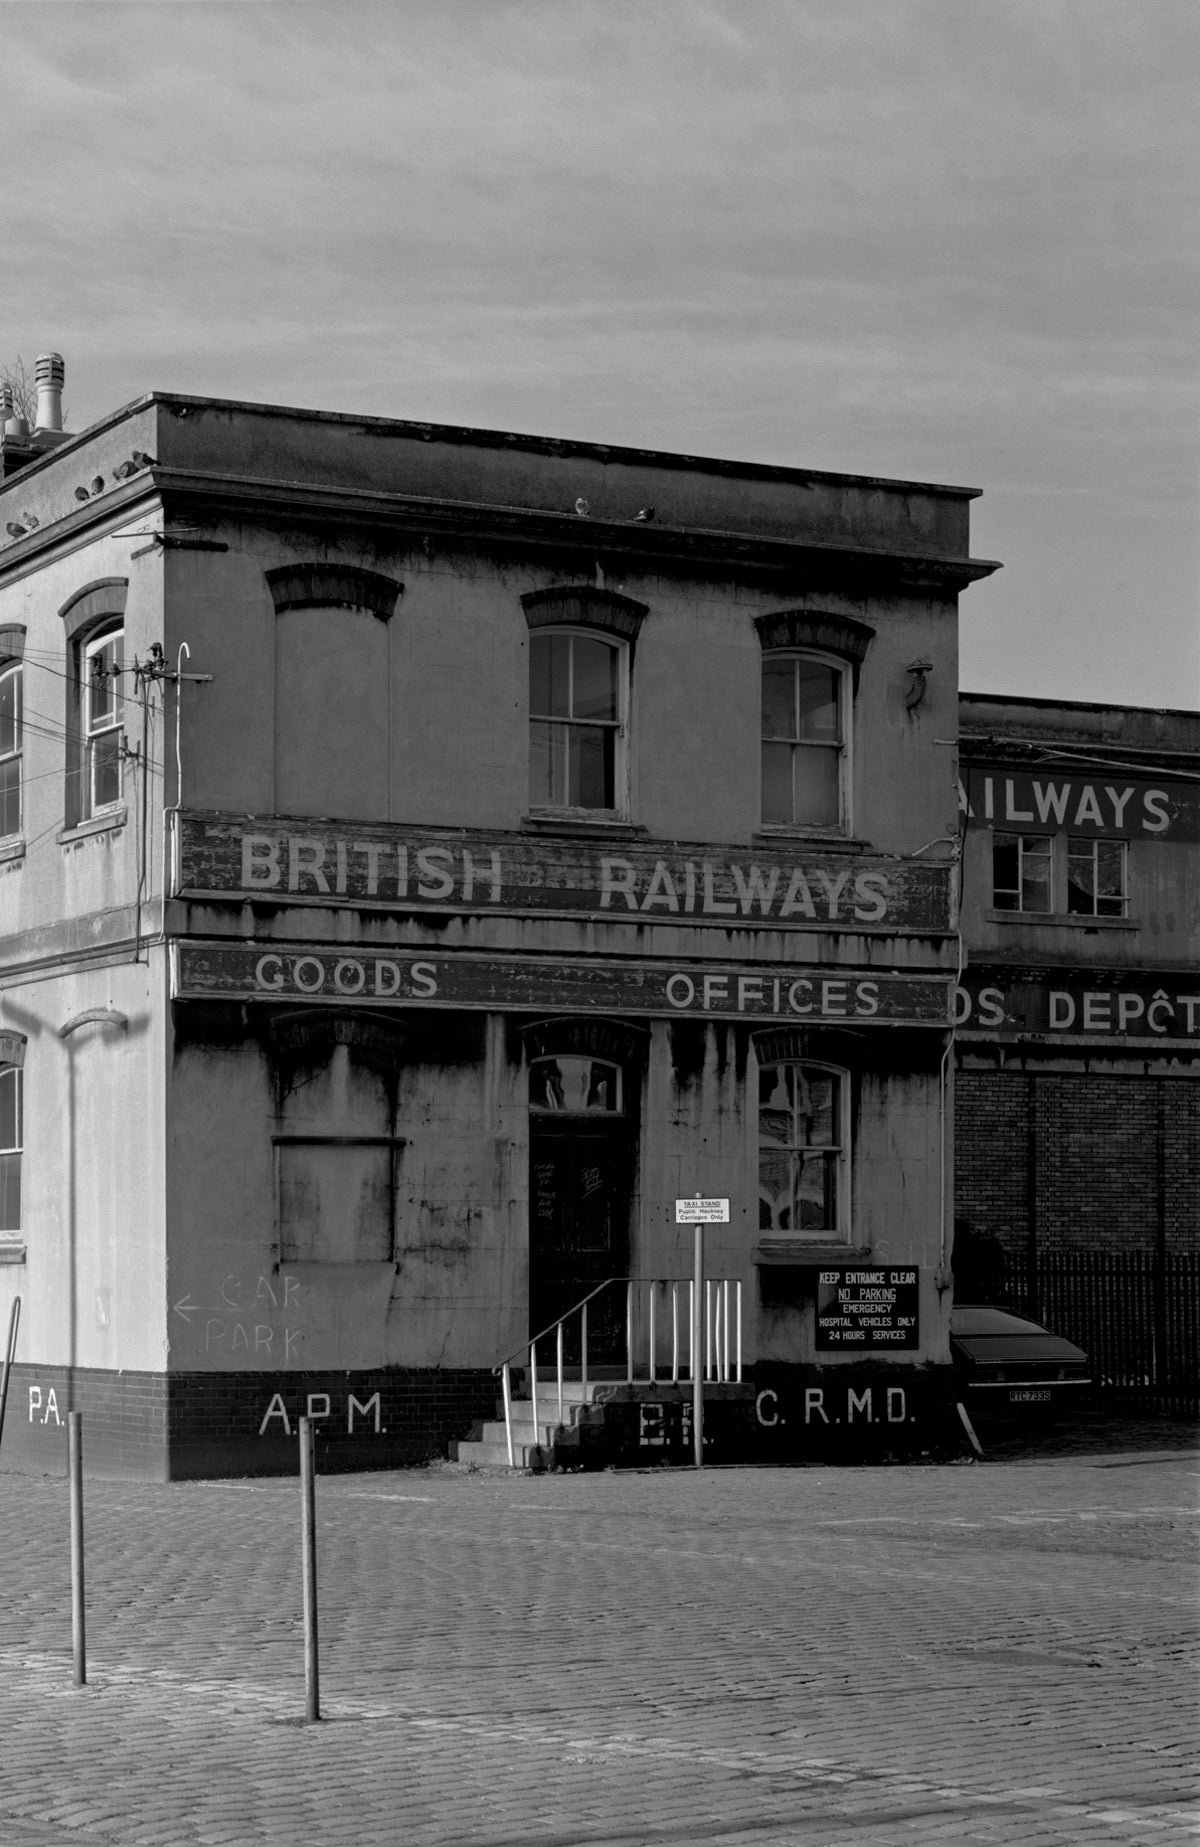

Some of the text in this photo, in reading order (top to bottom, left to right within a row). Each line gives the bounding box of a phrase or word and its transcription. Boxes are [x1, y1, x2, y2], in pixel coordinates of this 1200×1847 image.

[241, 834, 888, 922] BRITISH RAILWAYS
[255, 953, 880, 1017] GOODS OFFICES
[1049, 988, 1200, 1034] DEPÔT
[220, 1274, 301, 1309] CAR
[819, 1272, 916, 1284] KEEP ENTRANCE CLEAR
[838, 1288, 896, 1300] NO PARKING
[819, 1317, 916, 1327] HOSPITAL VEHICLES ONLY
[843, 1304, 892, 1313] EMERGENCY
[206, 1319, 306, 1361] PARK
[829, 1331, 906, 1340] 24 HOURS SERVICES
[29, 1386, 65, 1426] P.A.
